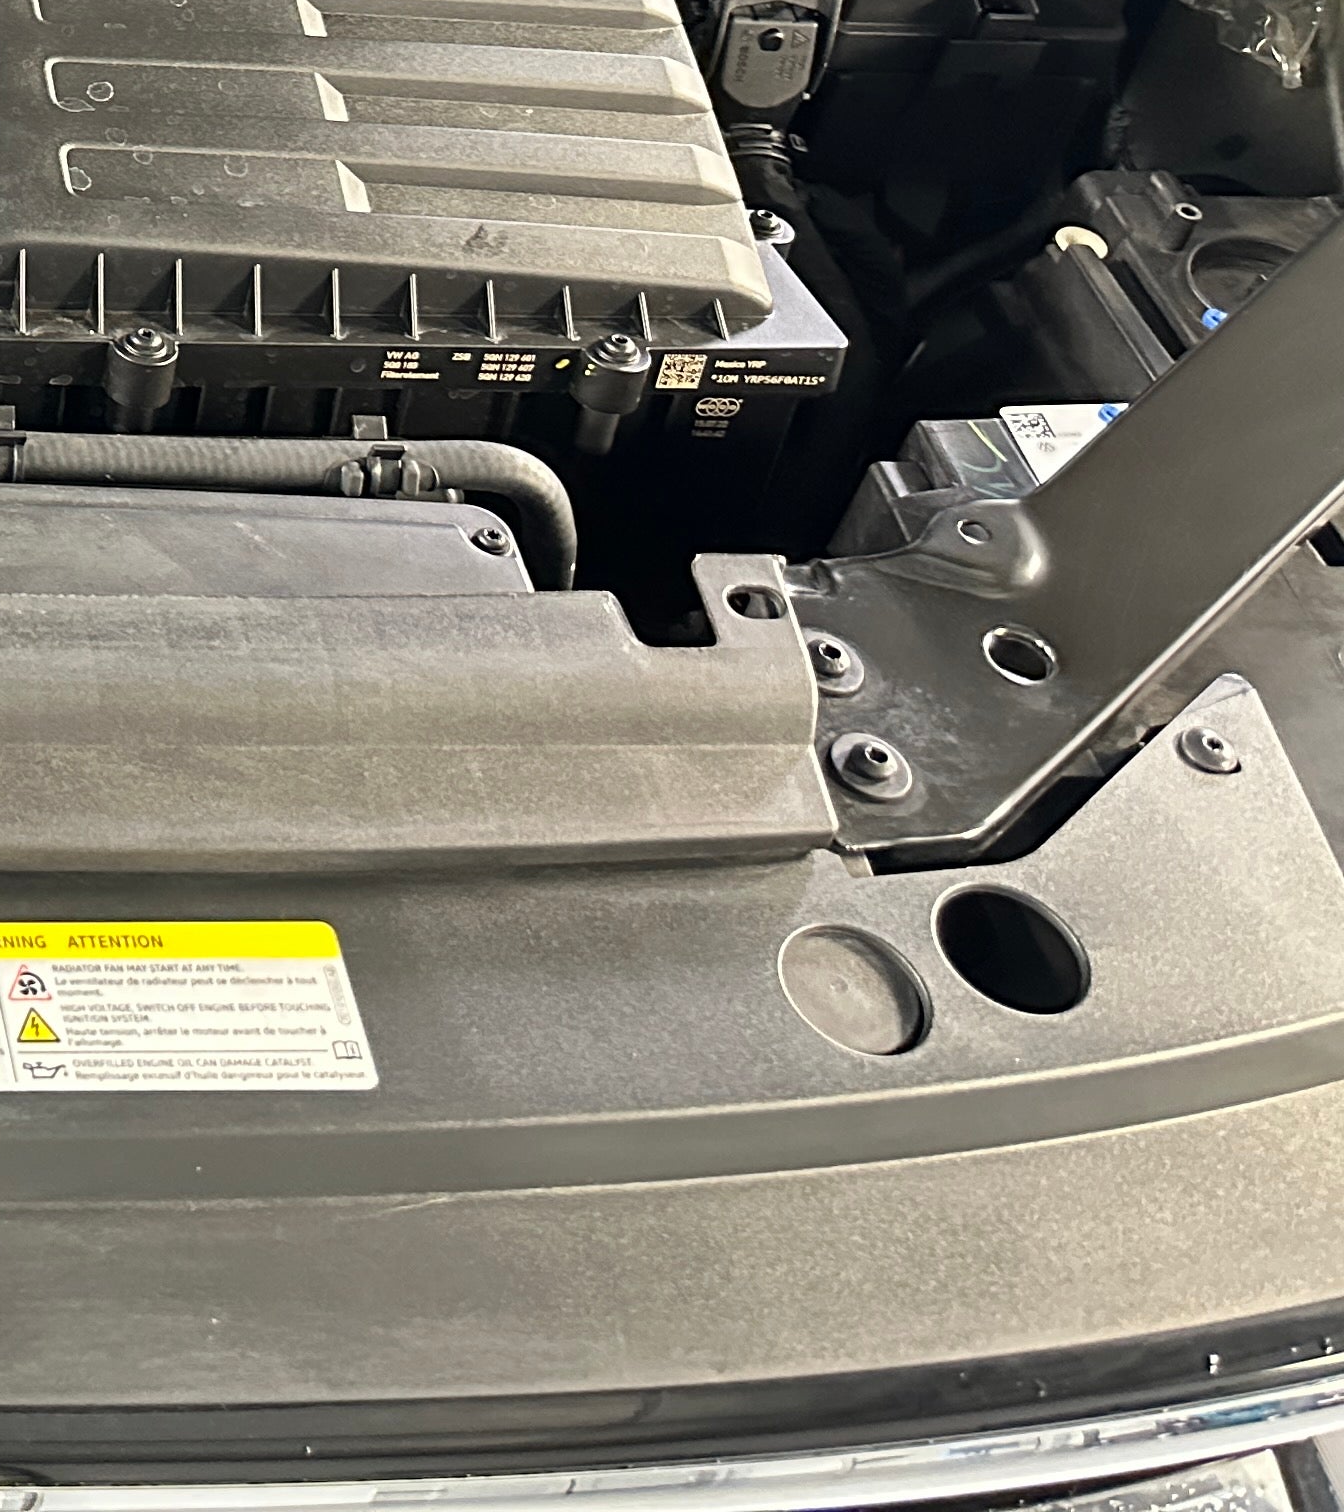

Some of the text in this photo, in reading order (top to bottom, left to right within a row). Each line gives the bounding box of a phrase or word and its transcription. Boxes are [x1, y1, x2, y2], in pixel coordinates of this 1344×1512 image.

[386, 350, 420, 360] VW AG
[504, 353, 520, 362] 129
[520, 354, 537, 363] 601
[501, 363, 518, 372] 129
[746, 360, 767, 369] YRP
[498, 373, 515, 381] 129
[68, 935, 163, 949] ATTENTION
